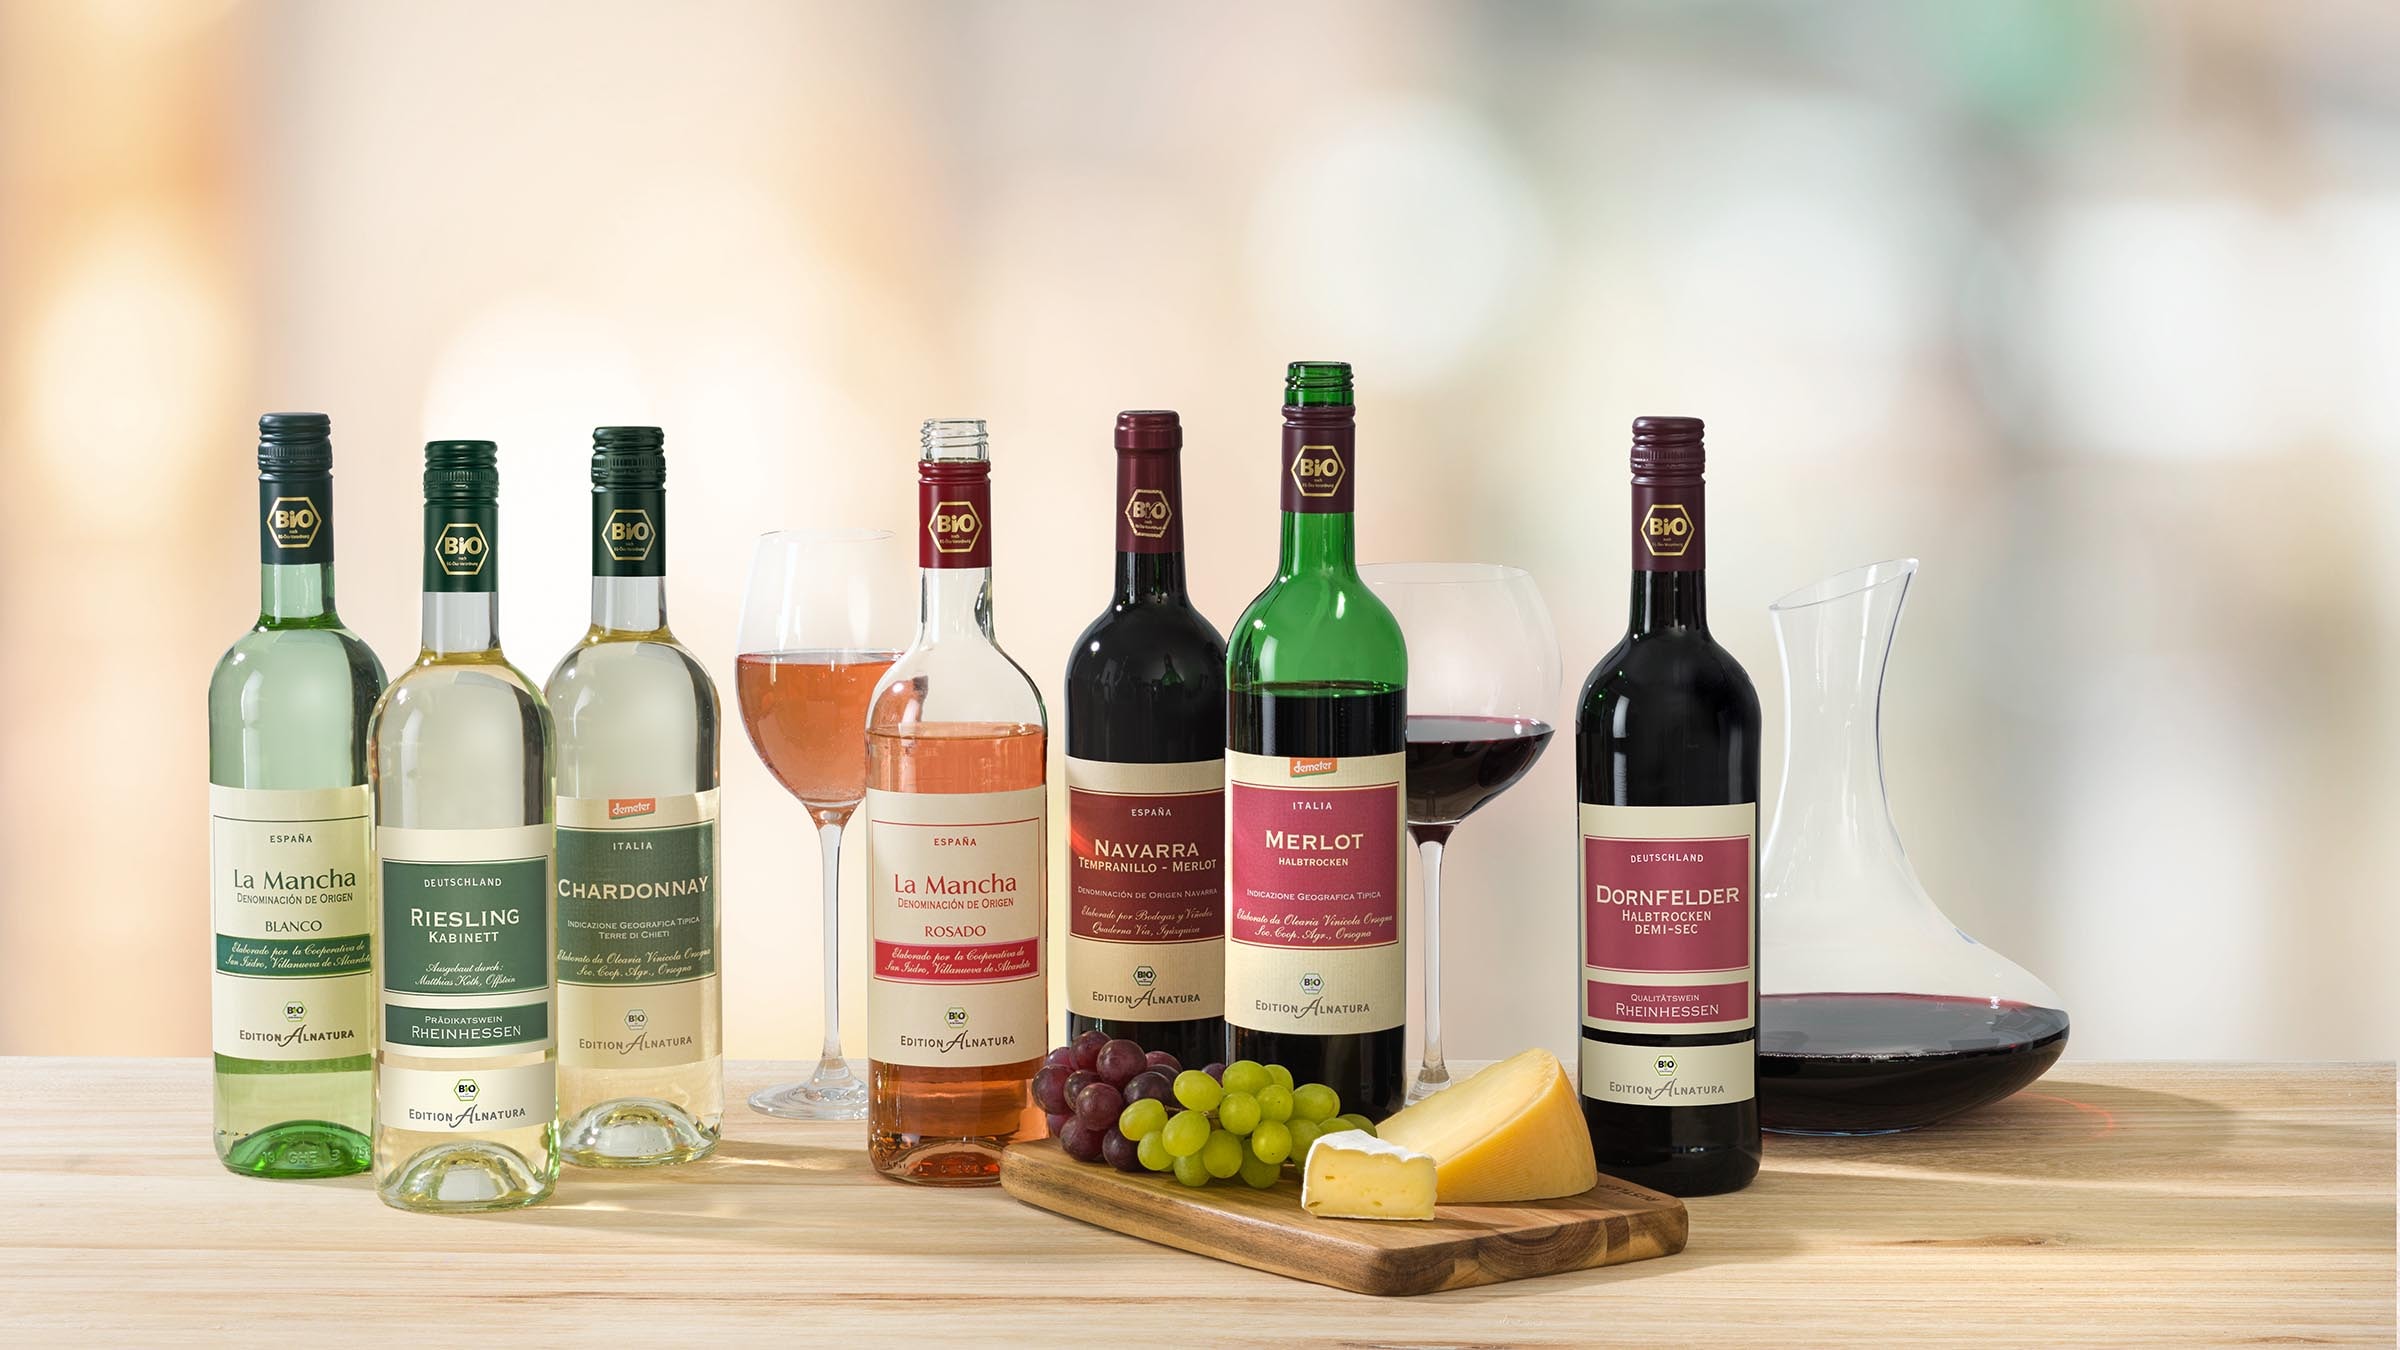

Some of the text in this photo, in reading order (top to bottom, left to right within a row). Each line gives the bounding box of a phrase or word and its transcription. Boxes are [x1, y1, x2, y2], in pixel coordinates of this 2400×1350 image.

[1294, 760, 1332, 774] demeter
[612, 800, 651, 816] demeter
[1131, 806, 1172, 817] ESPAÑA
[1292, 802, 1332, 810] ITALIA
[270, 833, 313, 843] ESPAÑA
[934, 836, 977, 846] ESPAÑA
[1265, 830, 1364, 851] MERLOT
[613, 842, 653, 850] ITALIA
[1094, 838, 1200, 858] NAVARRA
[1078, 856, 1157, 873] TEMPRANILLO
[1172, 858, 1217, 872] MERLOT
[1278, 857, 1349, 867] HALBTROCKEN
[1630, 854, 1704, 863] DEUTSCHLAND
[234, 869, 356, 890] La Mancha
[424, 878, 502, 888] DEUTSCHLAND
[894, 873, 1017, 895] La Mancha
[558, 875, 709, 900] CHARDONNAY
[1596, 884, 1740, 906] DORNFELDER
[305, 895, 317, 904] DE
[320, 892, 353, 904] ORIGEN
[967, 900, 980, 910] DE
[982, 898, 1014, 909] ORIGEN
[410, 908, 520, 928] RIESLING
[1081, 905, 1116, 919] Elaborado
[1116, 910, 1133, 922] por
[1135, 910, 1176, 923] Bodegas
[1178, 912, 1185, 923] y
[1270, 914, 1280, 925] da
[1323, 914, 1361, 926] Vinicola
[1622, 910, 1712, 922] HALBTROCKEN
[265, 920, 322, 932] BLANCO
[924, 926, 986, 938] ROSADO
[1634, 924, 1698, 935] DEMI-SEC
[428, 931, 499, 944] KABINETT
[598, 931, 627, 940] TERRE
[640, 930, 670, 939] CHIETI
[1335, 927, 1372, 942] Orsogna
[232, 940, 365, 959] Elaborado por la Cooperativa de
[892, 946, 1025, 965] Elaborado por la Cooperativa de
[270, 956, 320, 969] Villanueva
[321, 956, 332, 968] de
[592, 953, 603, 964] da
[426, 961, 503, 976] Ausgebaut durch:
[933, 963, 982, 974] Villanueva
[984, 963, 994, 973] de
[415, 975, 454, 986] Matthias
[1092, 988, 1201, 1009] EDITION ALNATURA
[1256, 996, 1370, 1019] EDITION ALNATURA
[1616, 1002, 1719, 1018] RHEINHESSEN
[240, 1024, 355, 1048] EDITION ALNATURA
[412, 1025, 521, 1040] RHEINHESSEN
[579, 1032, 692, 1055] EDITION ALNATURA
[900, 1030, 1016, 1053] EDITION ALNATURA
[1610, 1078, 1725, 1100] EDITION ALNATURA
[409, 1104, 526, 1128] EDITION ALNATURA
